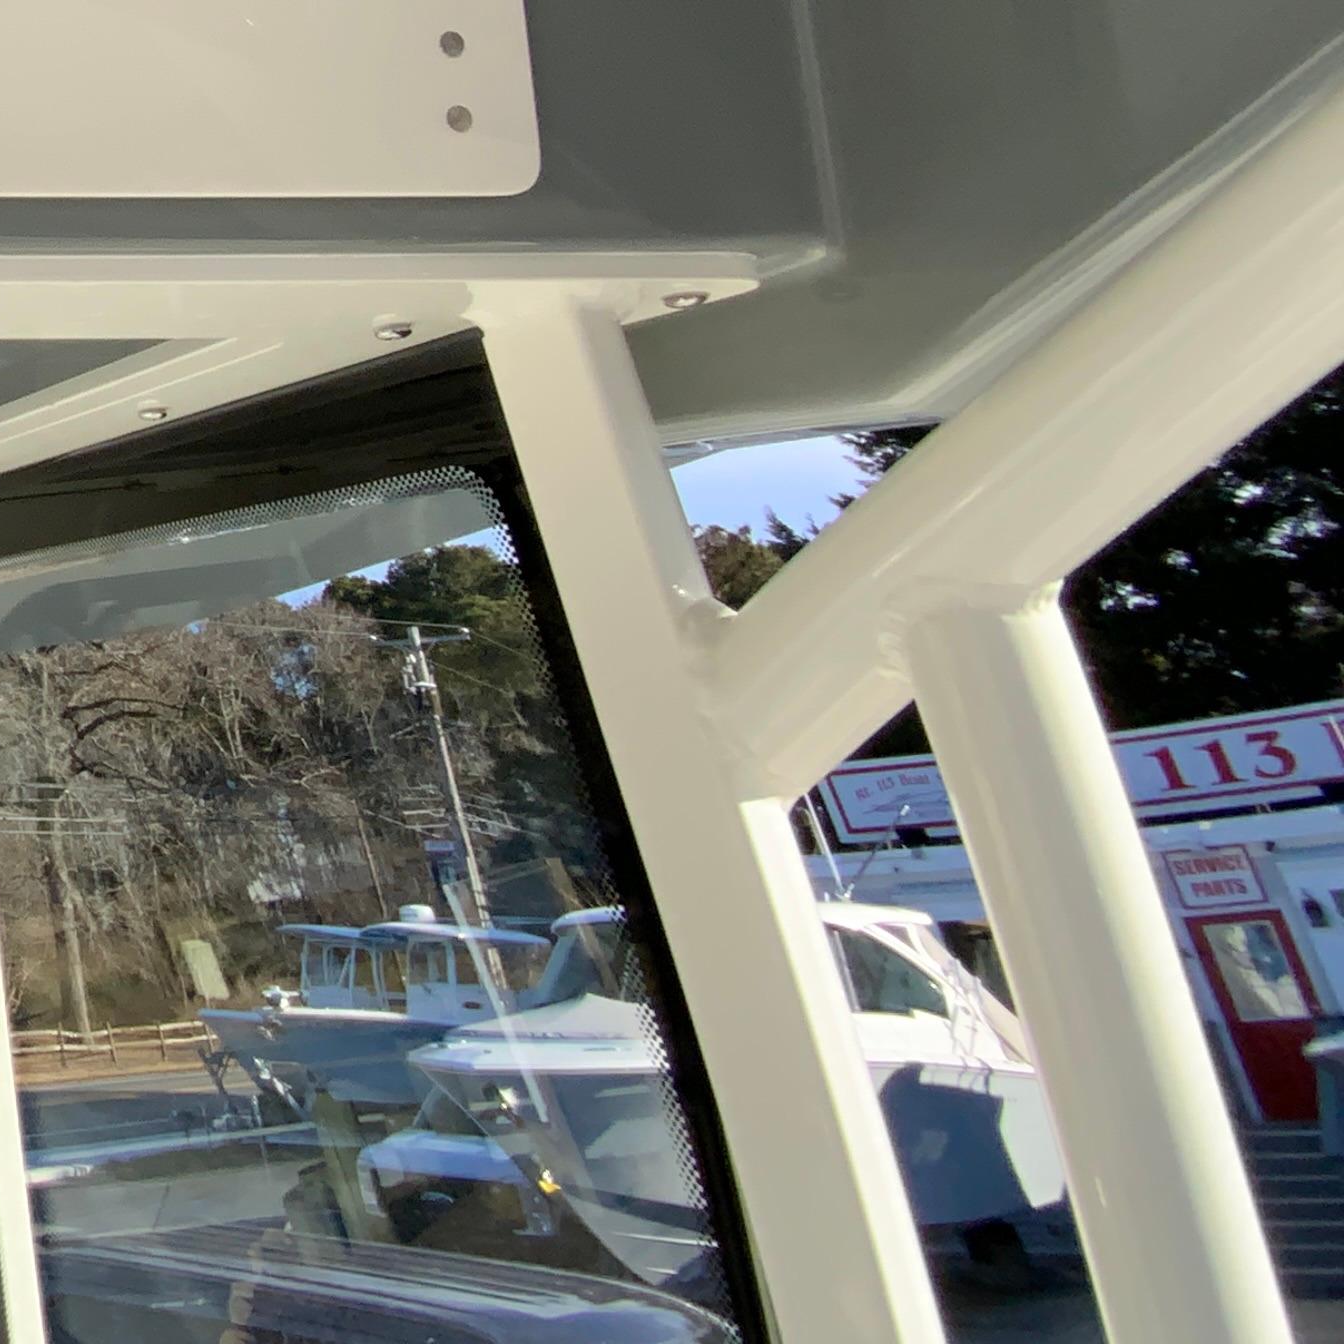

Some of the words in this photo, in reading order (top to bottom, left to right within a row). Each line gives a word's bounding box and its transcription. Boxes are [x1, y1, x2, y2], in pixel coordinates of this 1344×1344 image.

[1143, 730, 1298, 792] 113
[1173, 855, 1247, 876] SERVICE
[1190, 878, 1248, 898] PARTS
